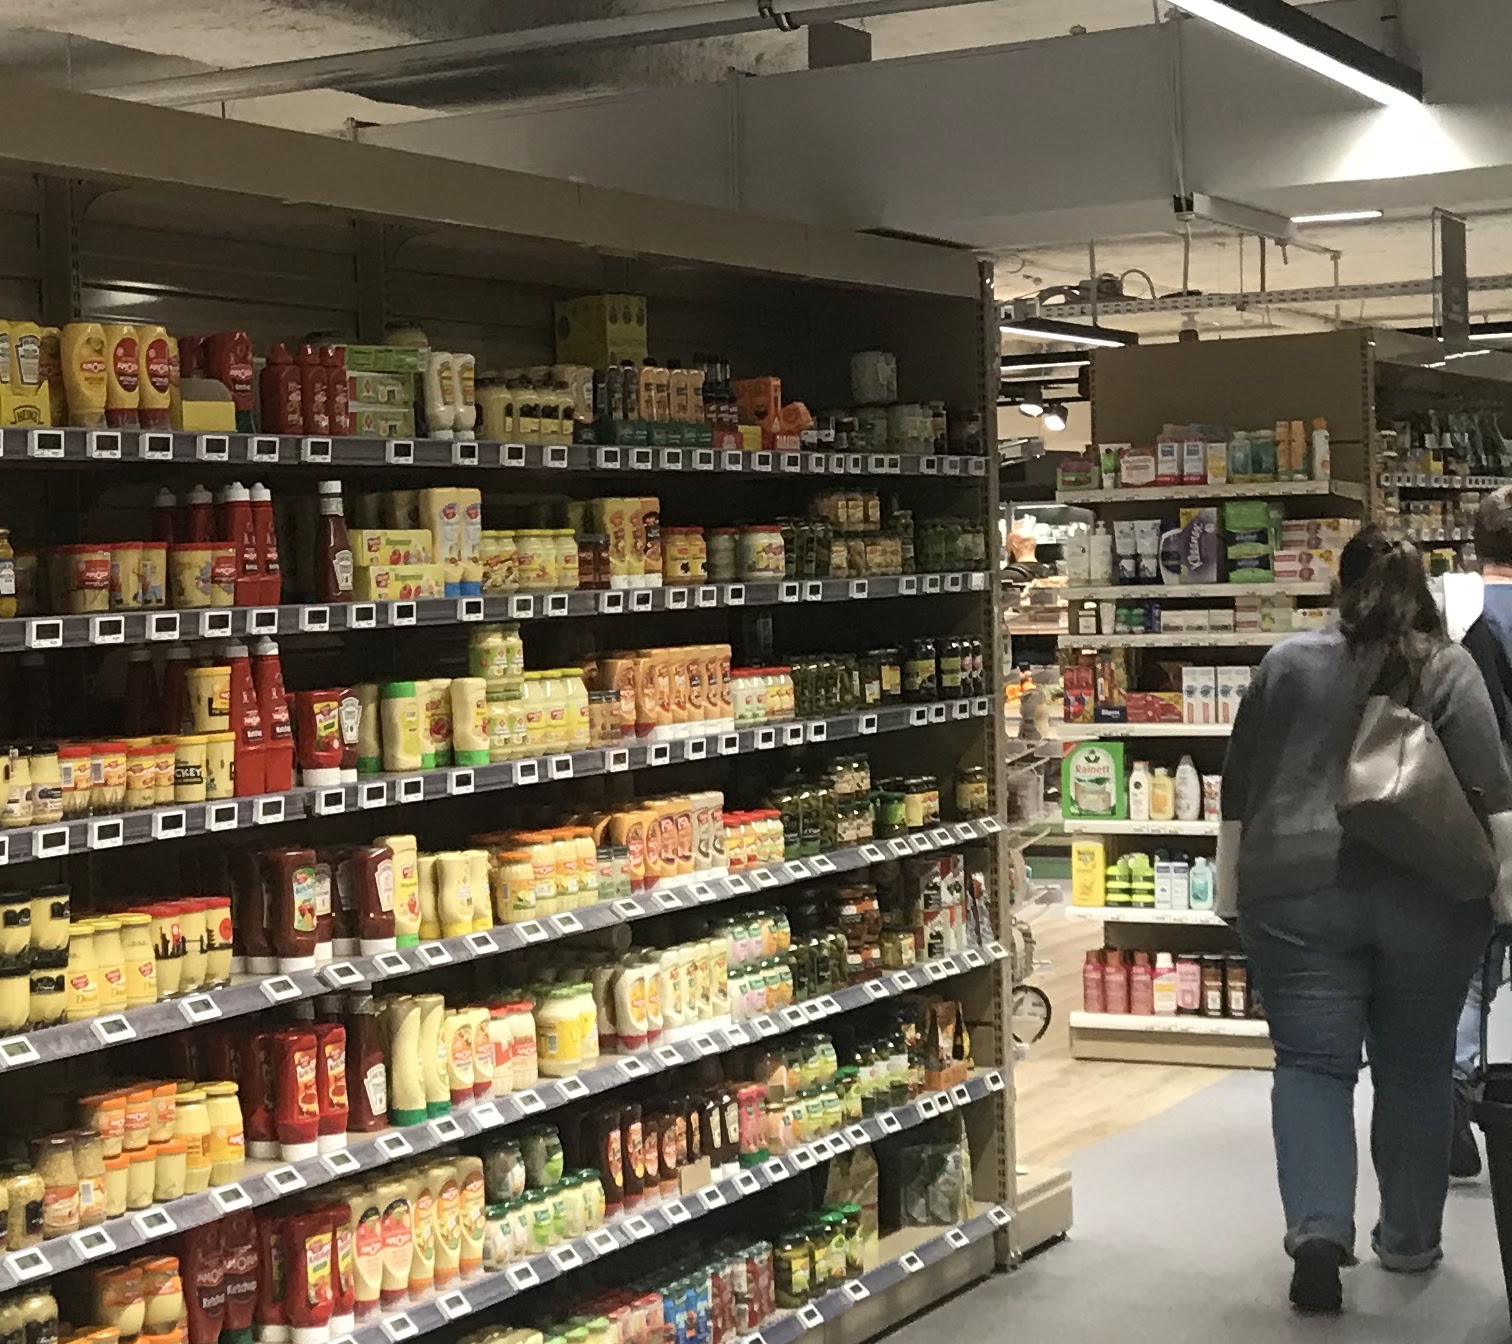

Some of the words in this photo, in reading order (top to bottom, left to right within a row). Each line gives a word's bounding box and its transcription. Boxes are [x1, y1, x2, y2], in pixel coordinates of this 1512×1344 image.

[1187, 522, 1203, 570] Kleenex
[176, 769, 201, 777] CKEY
[1075, 763, 1110, 775] Rainett
